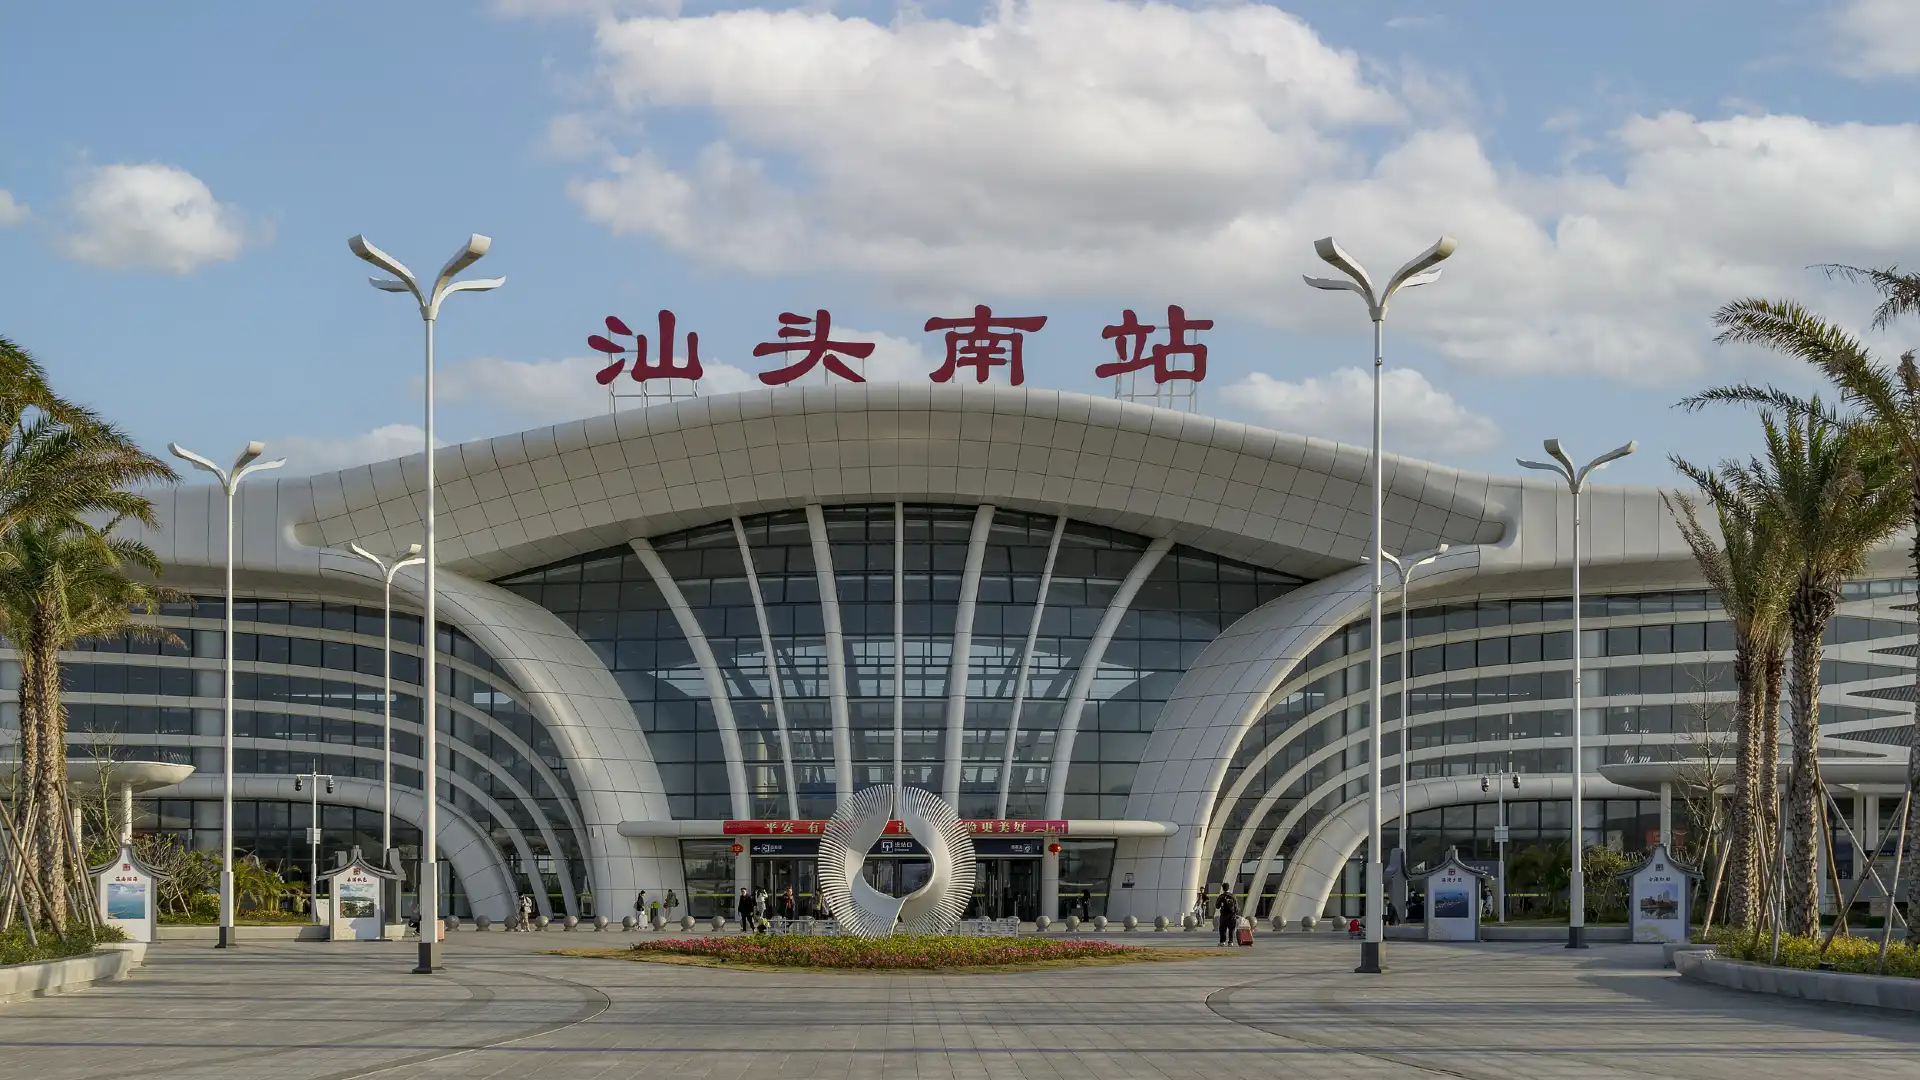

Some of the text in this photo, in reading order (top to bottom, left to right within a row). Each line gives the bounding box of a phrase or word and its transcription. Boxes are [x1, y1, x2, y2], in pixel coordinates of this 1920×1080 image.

[588, 304, 1213, 387] 汕头南站
[764, 821, 794, 833] 平安
